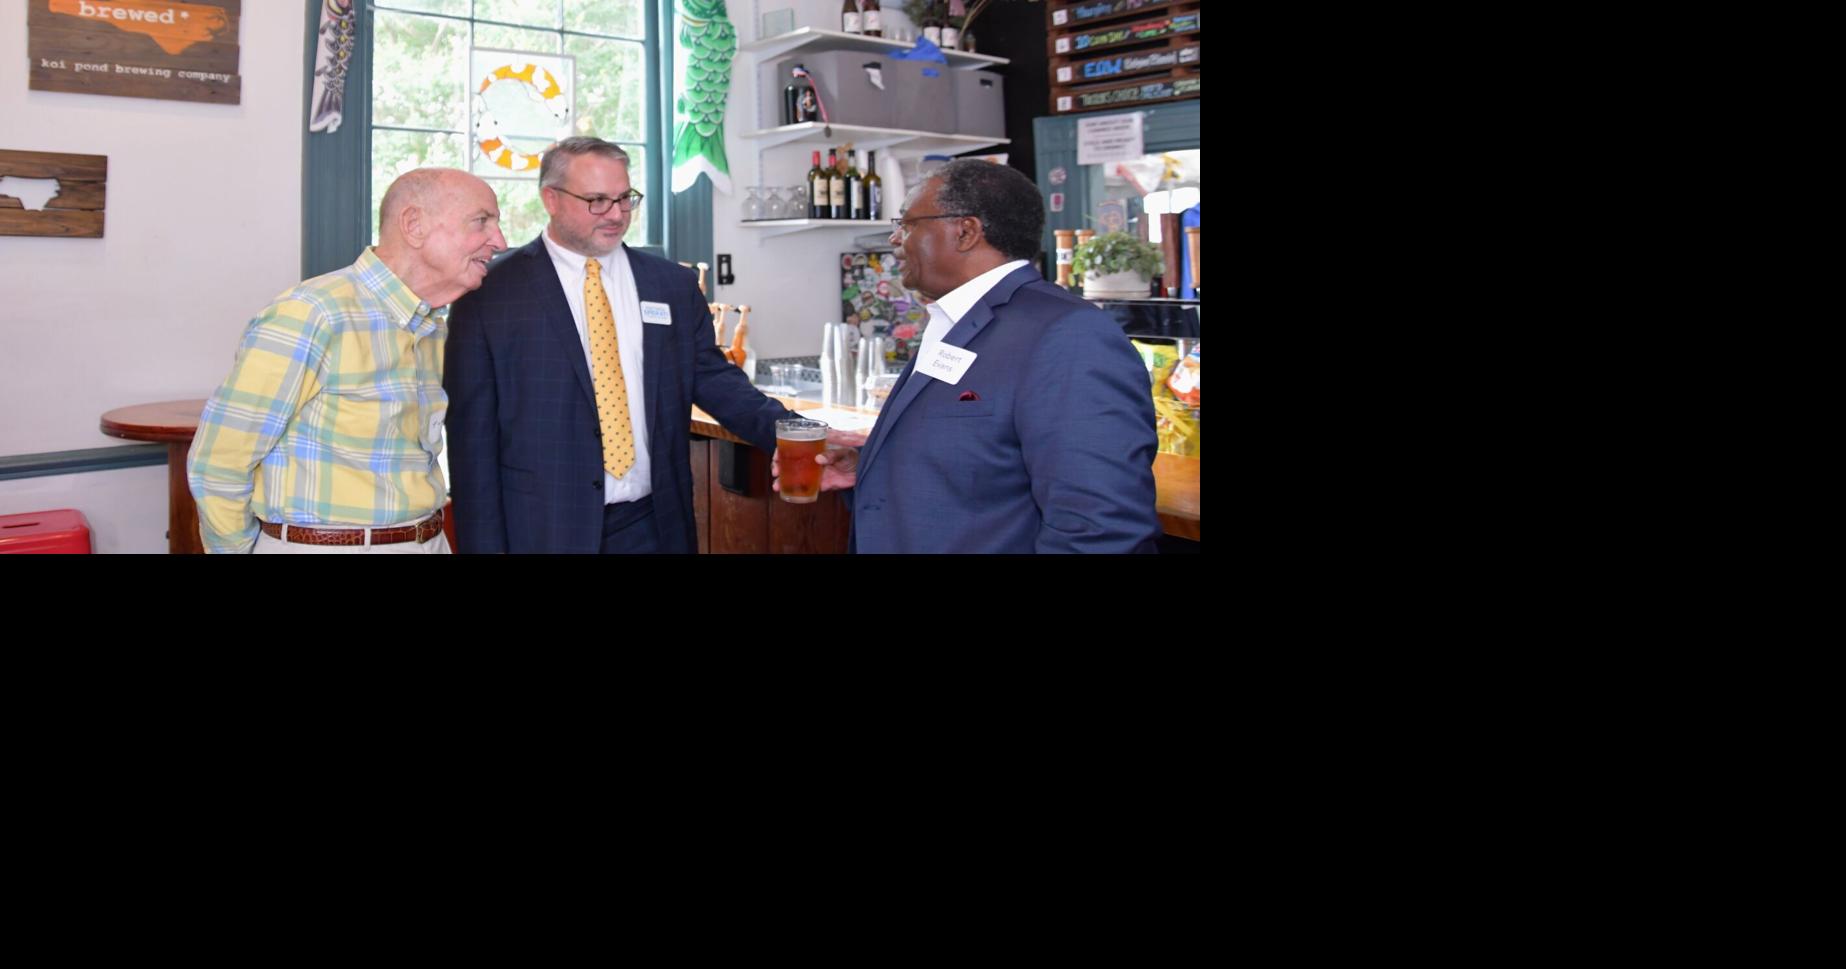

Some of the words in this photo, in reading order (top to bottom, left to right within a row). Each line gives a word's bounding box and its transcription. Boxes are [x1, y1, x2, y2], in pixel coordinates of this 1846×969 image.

[41, 58, 66, 69] koi
[75, 61, 108, 73] pond
[115, 64, 171, 78] brewing
[178, 69, 231, 83] company
[938, 349, 963, 363] Robert
[932, 359, 953, 373] Evans
